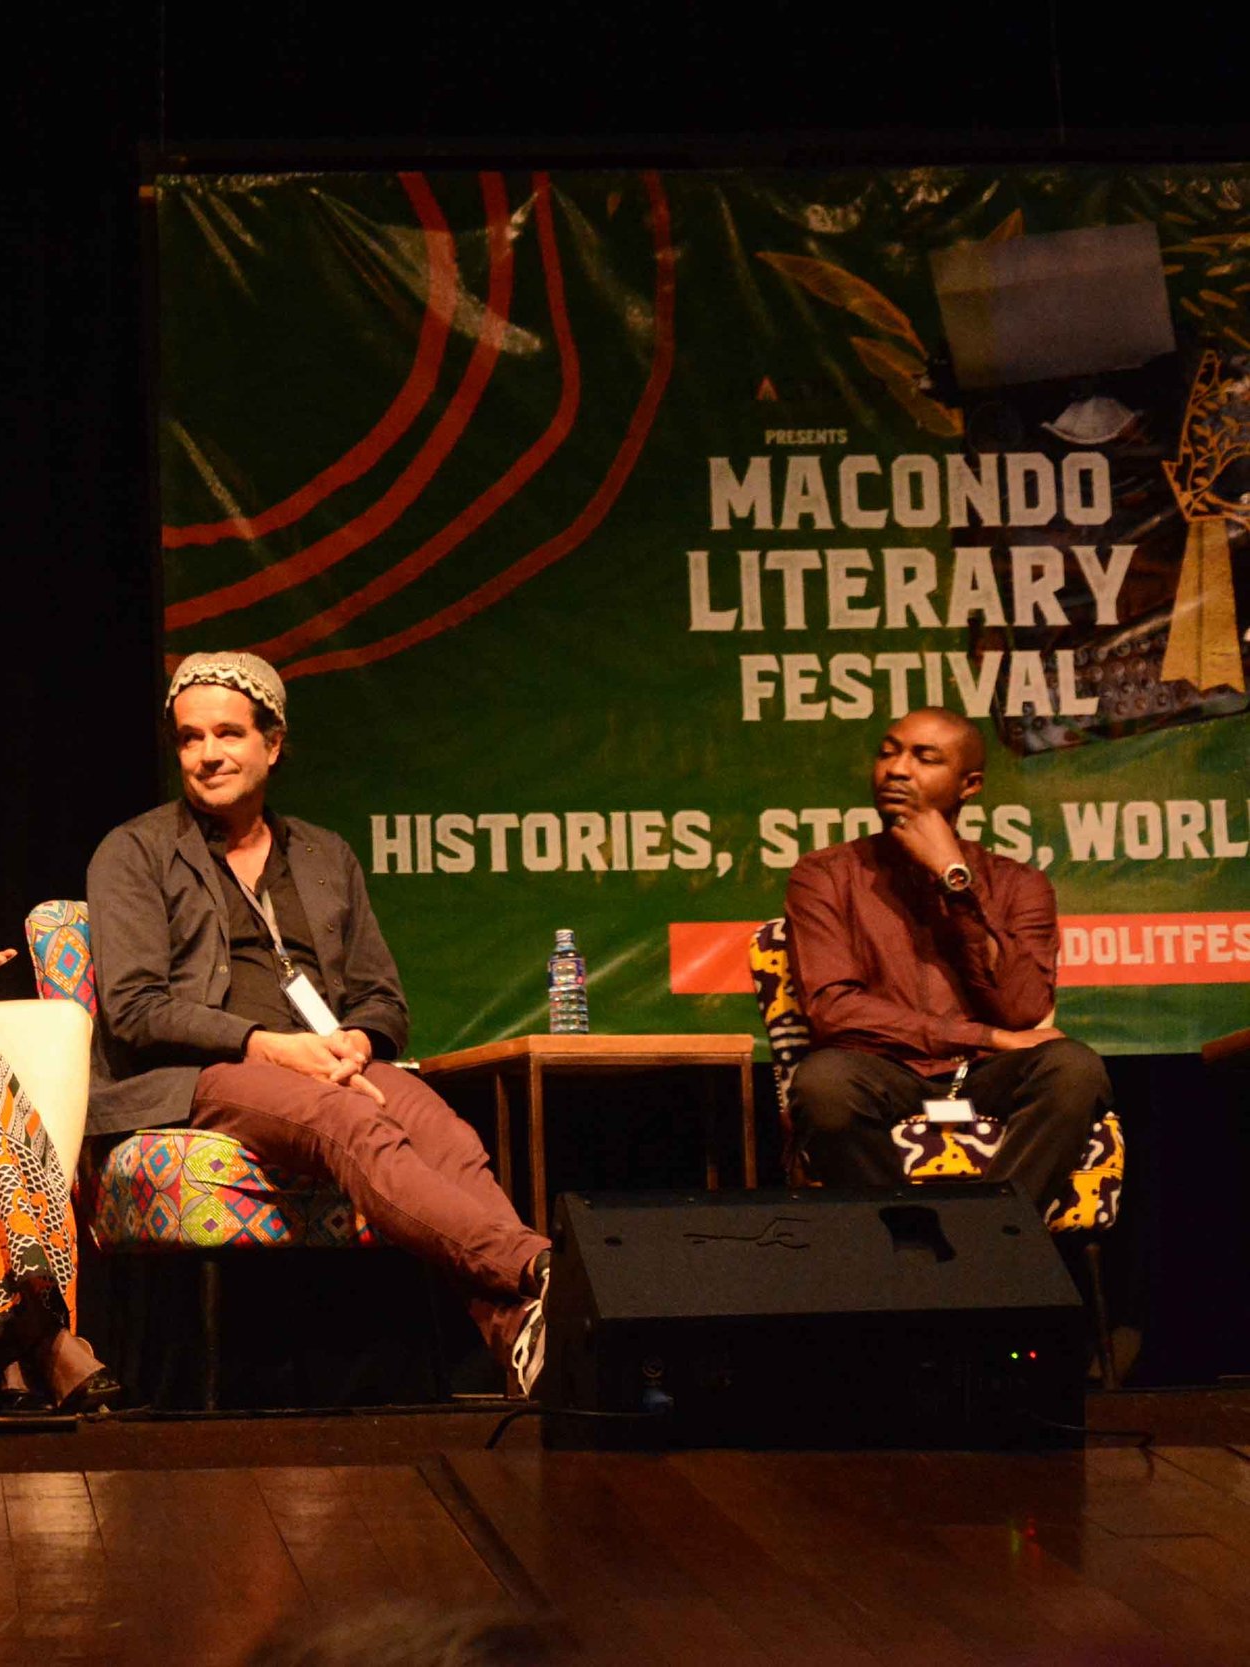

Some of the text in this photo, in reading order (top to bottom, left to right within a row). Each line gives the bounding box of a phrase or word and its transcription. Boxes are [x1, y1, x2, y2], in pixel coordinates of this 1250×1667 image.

[765, 429, 847, 445] PRESENTS
[708, 451, 1112, 531] MACONDO
[686, 544, 1138, 632] LITERARY
[739, 649, 1100, 722] FESTIVAL
[370, 810, 733, 877] HISTORIES,
[1061, 799, 1250, 862] WORL
